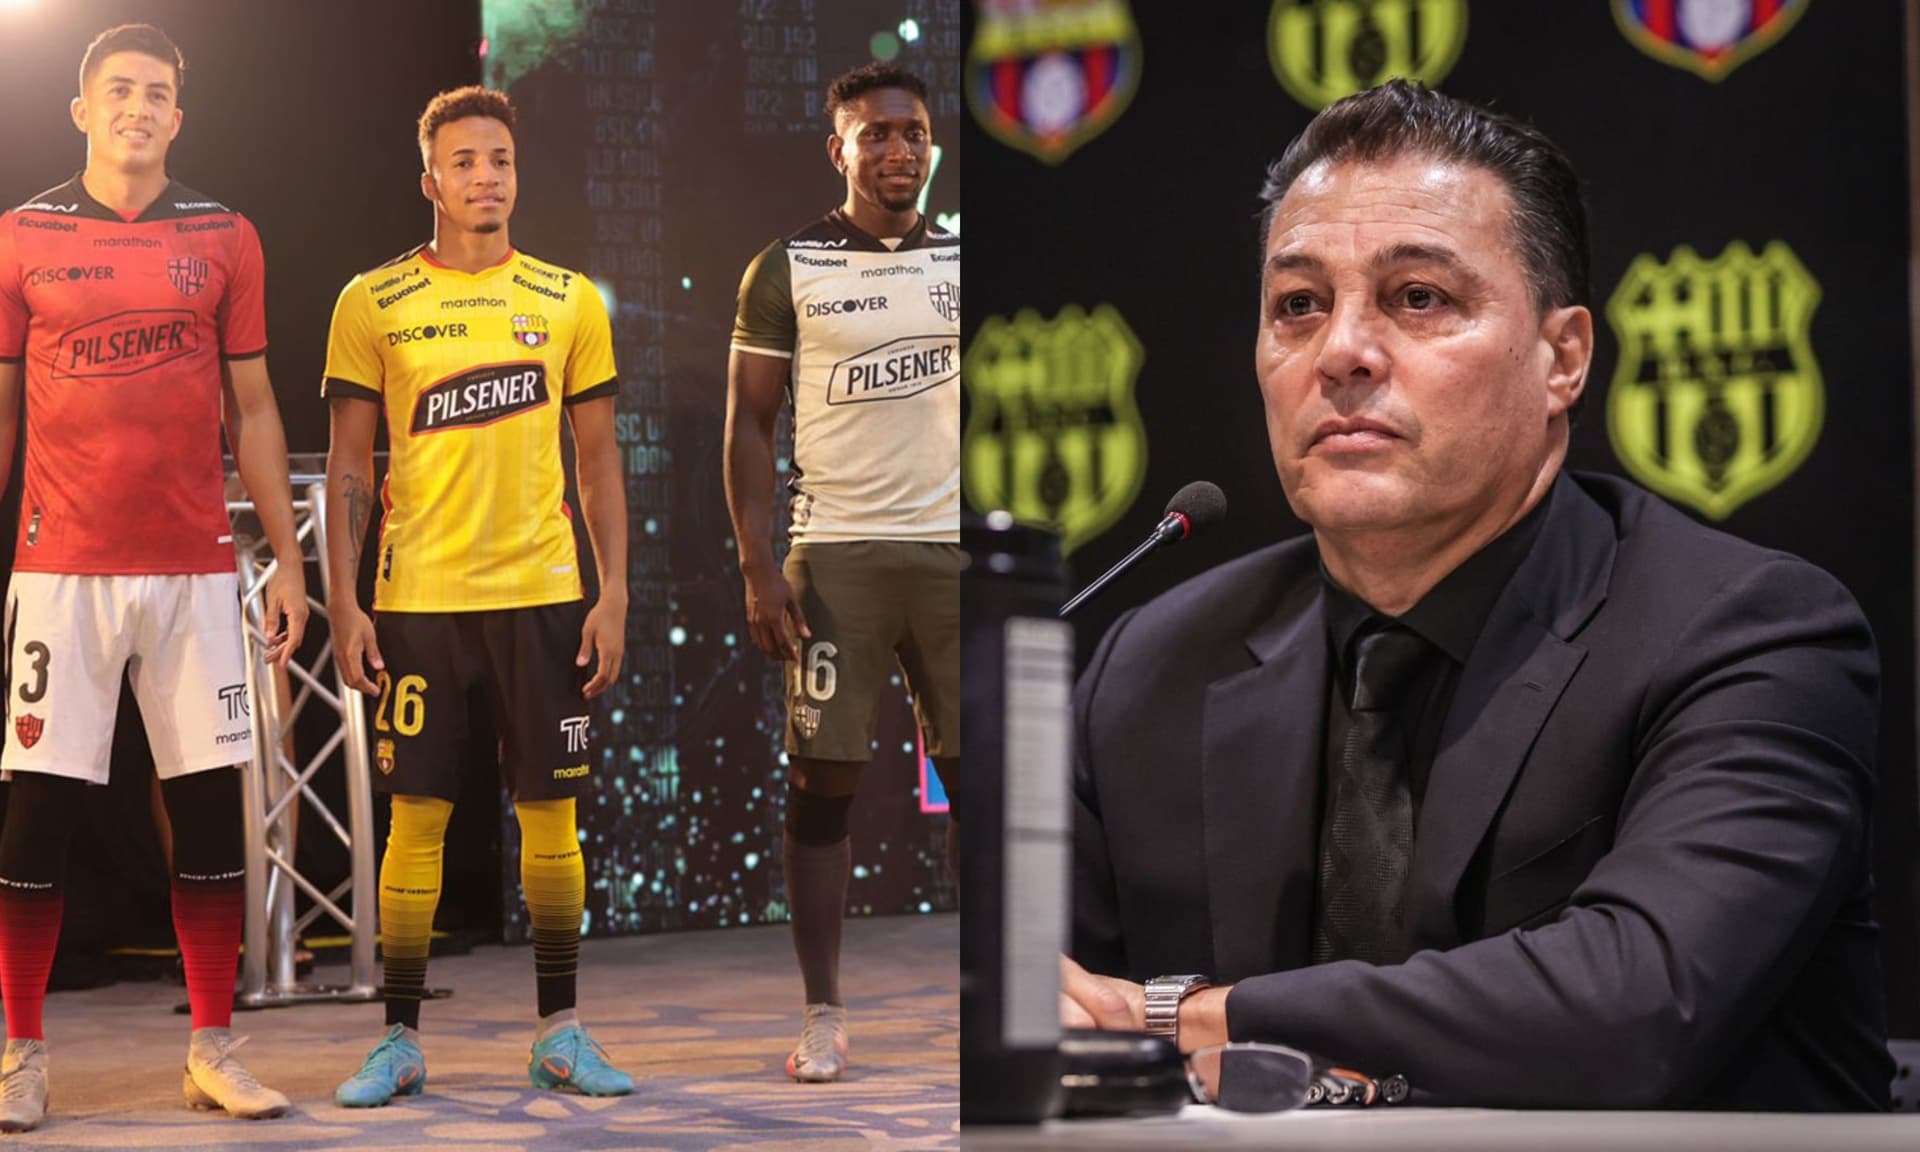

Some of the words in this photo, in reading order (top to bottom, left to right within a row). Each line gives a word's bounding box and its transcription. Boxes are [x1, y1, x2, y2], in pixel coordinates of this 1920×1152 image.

[18, 216, 78, 233] Ecuabet
[93, 236, 162, 249] marathon
[794, 253, 848, 268] Ecuabet
[861, 264, 924, 279] marathon
[30, 265, 115, 287] DISCOVER
[512, 273, 567, 302] Ecuabet
[377, 277, 432, 310] Ecuabet
[440, 296, 507, 310] marathon
[806, 296, 889, 318] DISCOVER
[70, 320, 187, 370] PILSENER
[387, 323, 469, 347] DISCOVER
[846, 344, 953, 396] PILSENER
[426, 370, 537, 427] PILSENER
[18, 640, 51, 704] 3
[374, 670, 428, 737] 26
